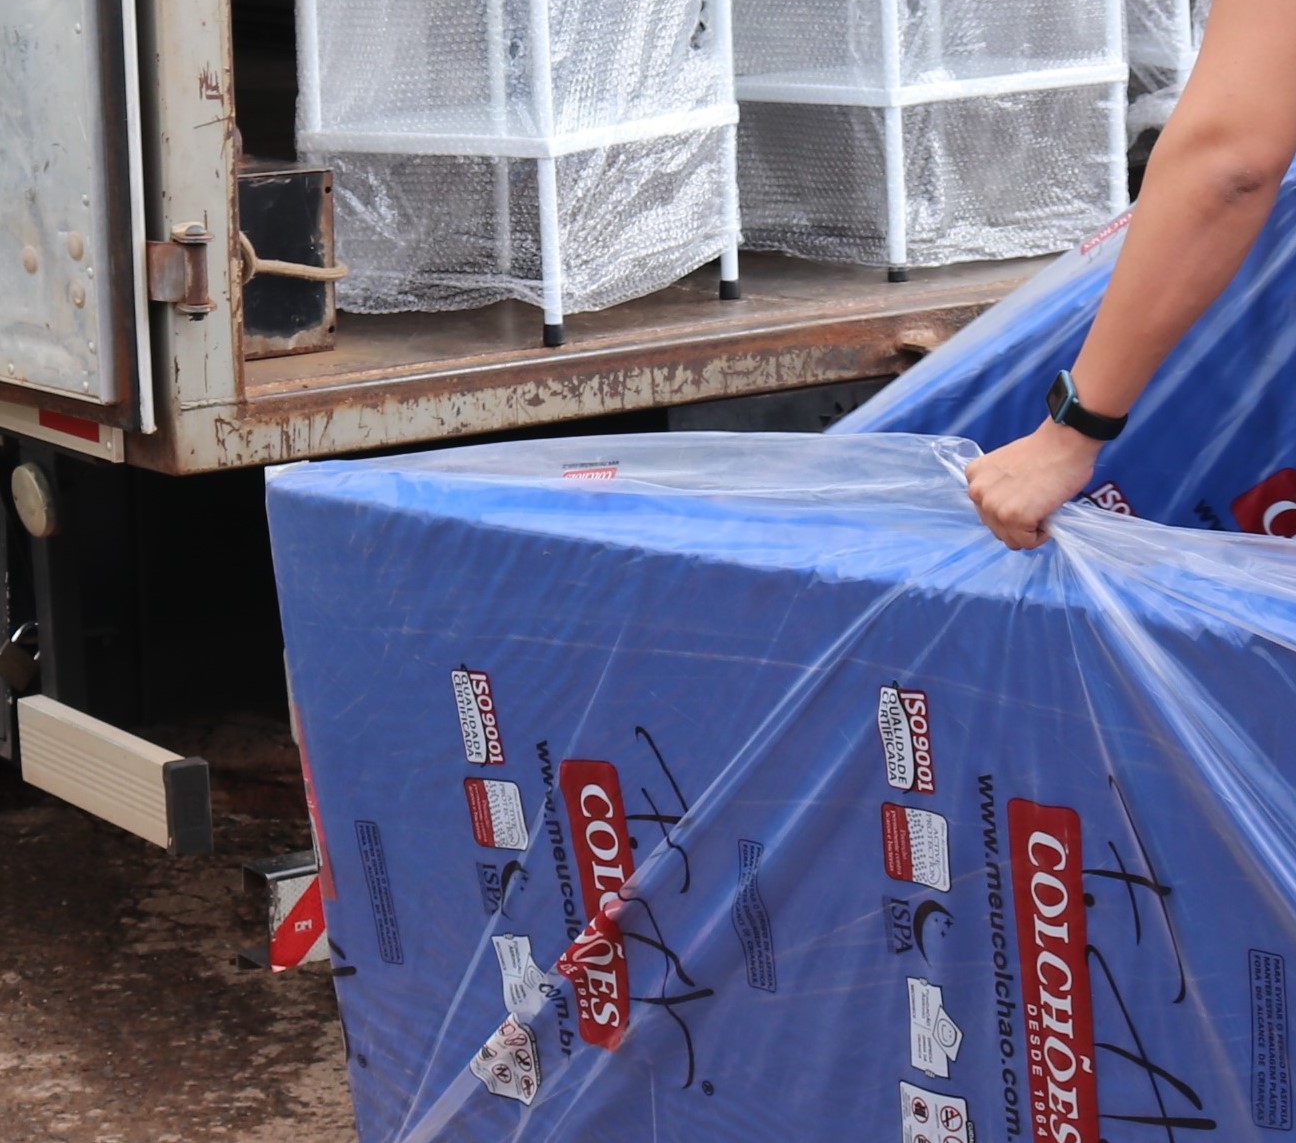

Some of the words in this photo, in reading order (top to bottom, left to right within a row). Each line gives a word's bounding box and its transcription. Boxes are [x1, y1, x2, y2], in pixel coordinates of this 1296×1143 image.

[451, 673, 474, 758] CERTIFICADA
[460, 673, 482, 758] QUALIDADE
[878, 691, 898, 782] CERTIFICADA
[887, 693, 910, 785] QUALIDADE
[889, 898, 915, 956] ISPA
[574, 977, 590, 1020] 1964
[1026, 830, 1092, 1143] COLCHÕES
[1026, 1003, 1043, 1077] DESDE
[1033, 1089, 1048, 1137] 1964
